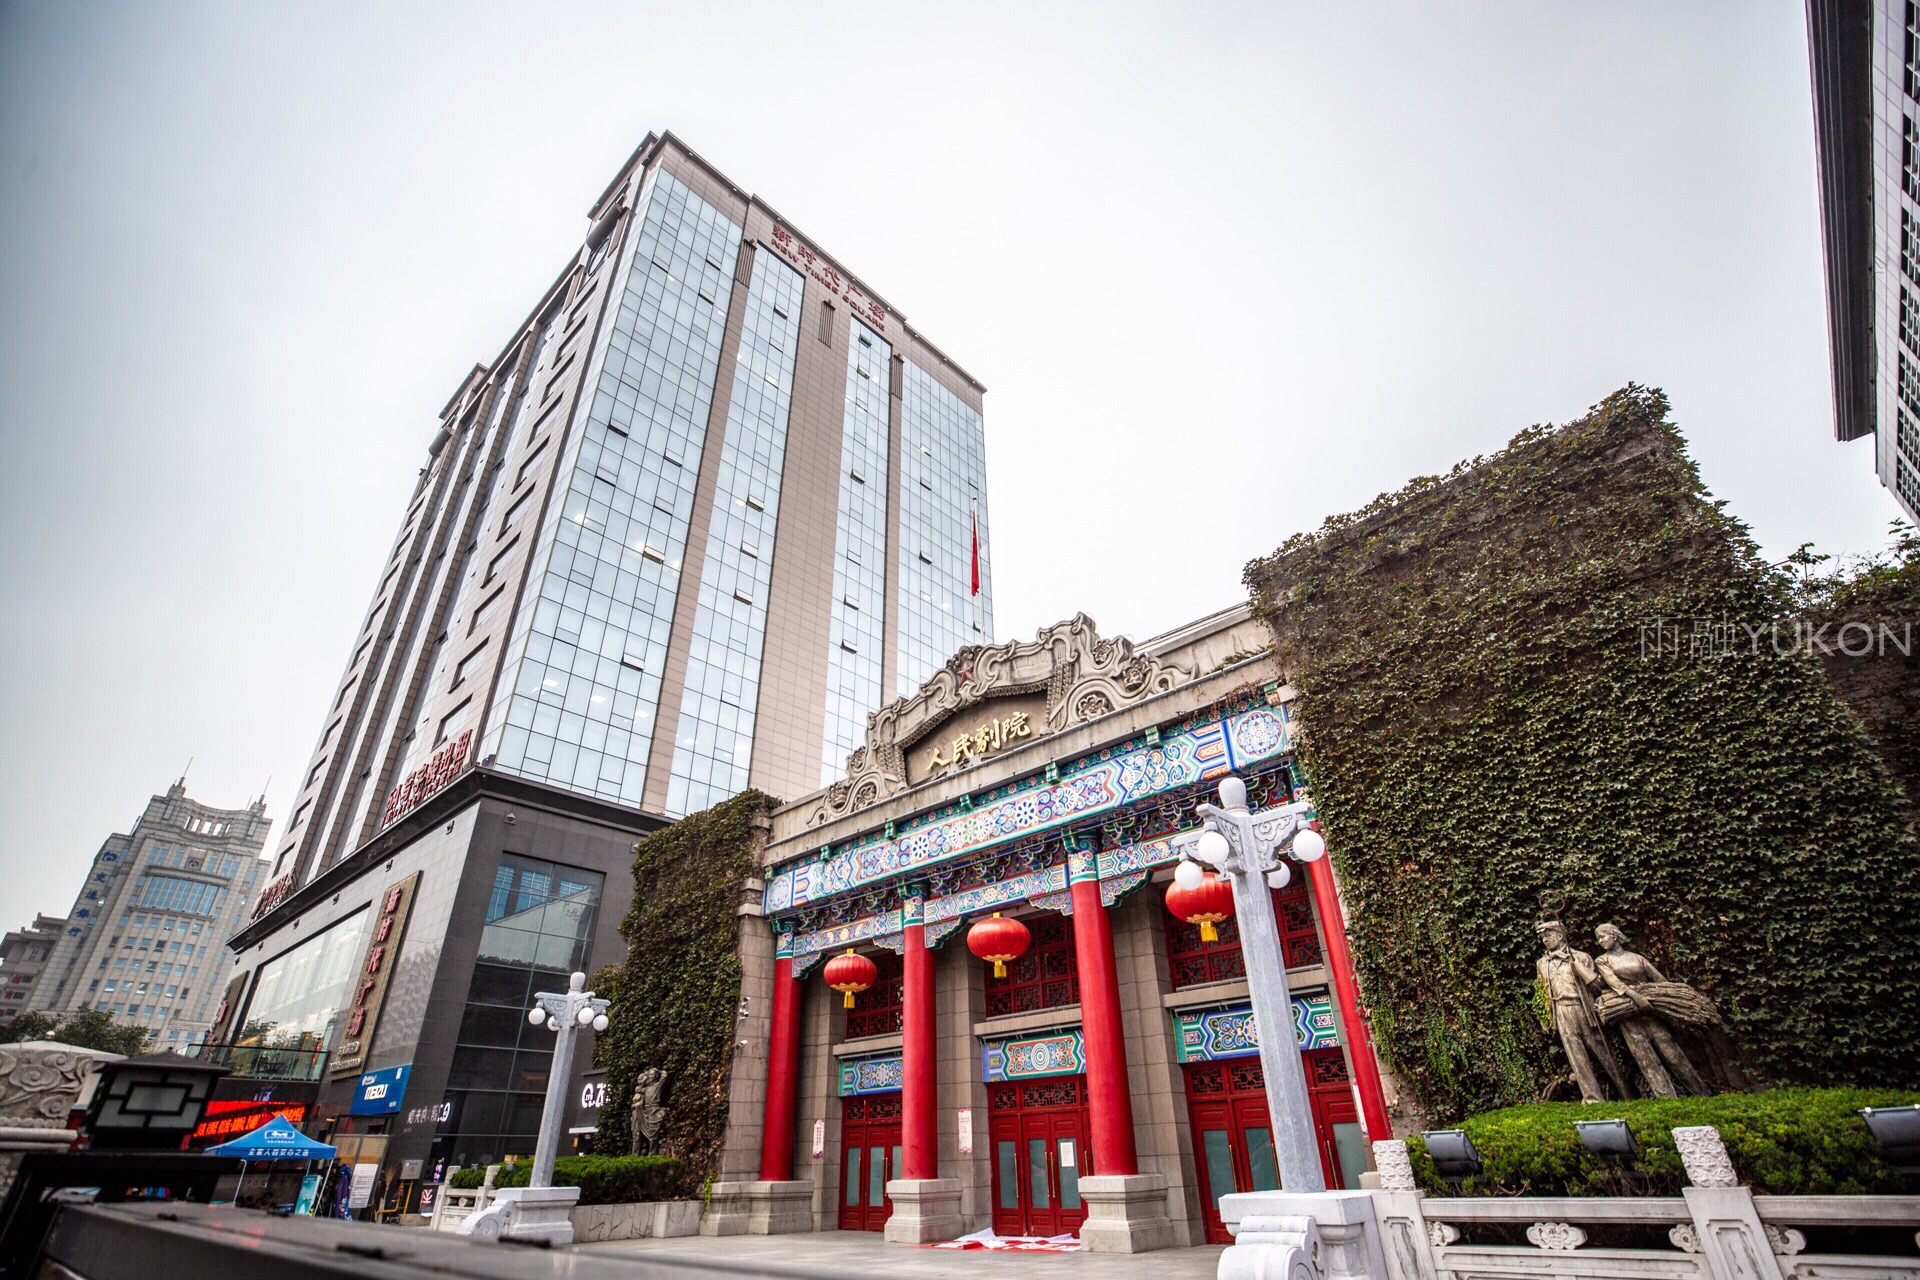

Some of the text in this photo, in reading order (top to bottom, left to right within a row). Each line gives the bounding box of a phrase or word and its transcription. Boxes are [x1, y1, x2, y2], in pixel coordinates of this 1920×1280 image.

[771, 239, 885, 331] NEW TIMES SQUARE
